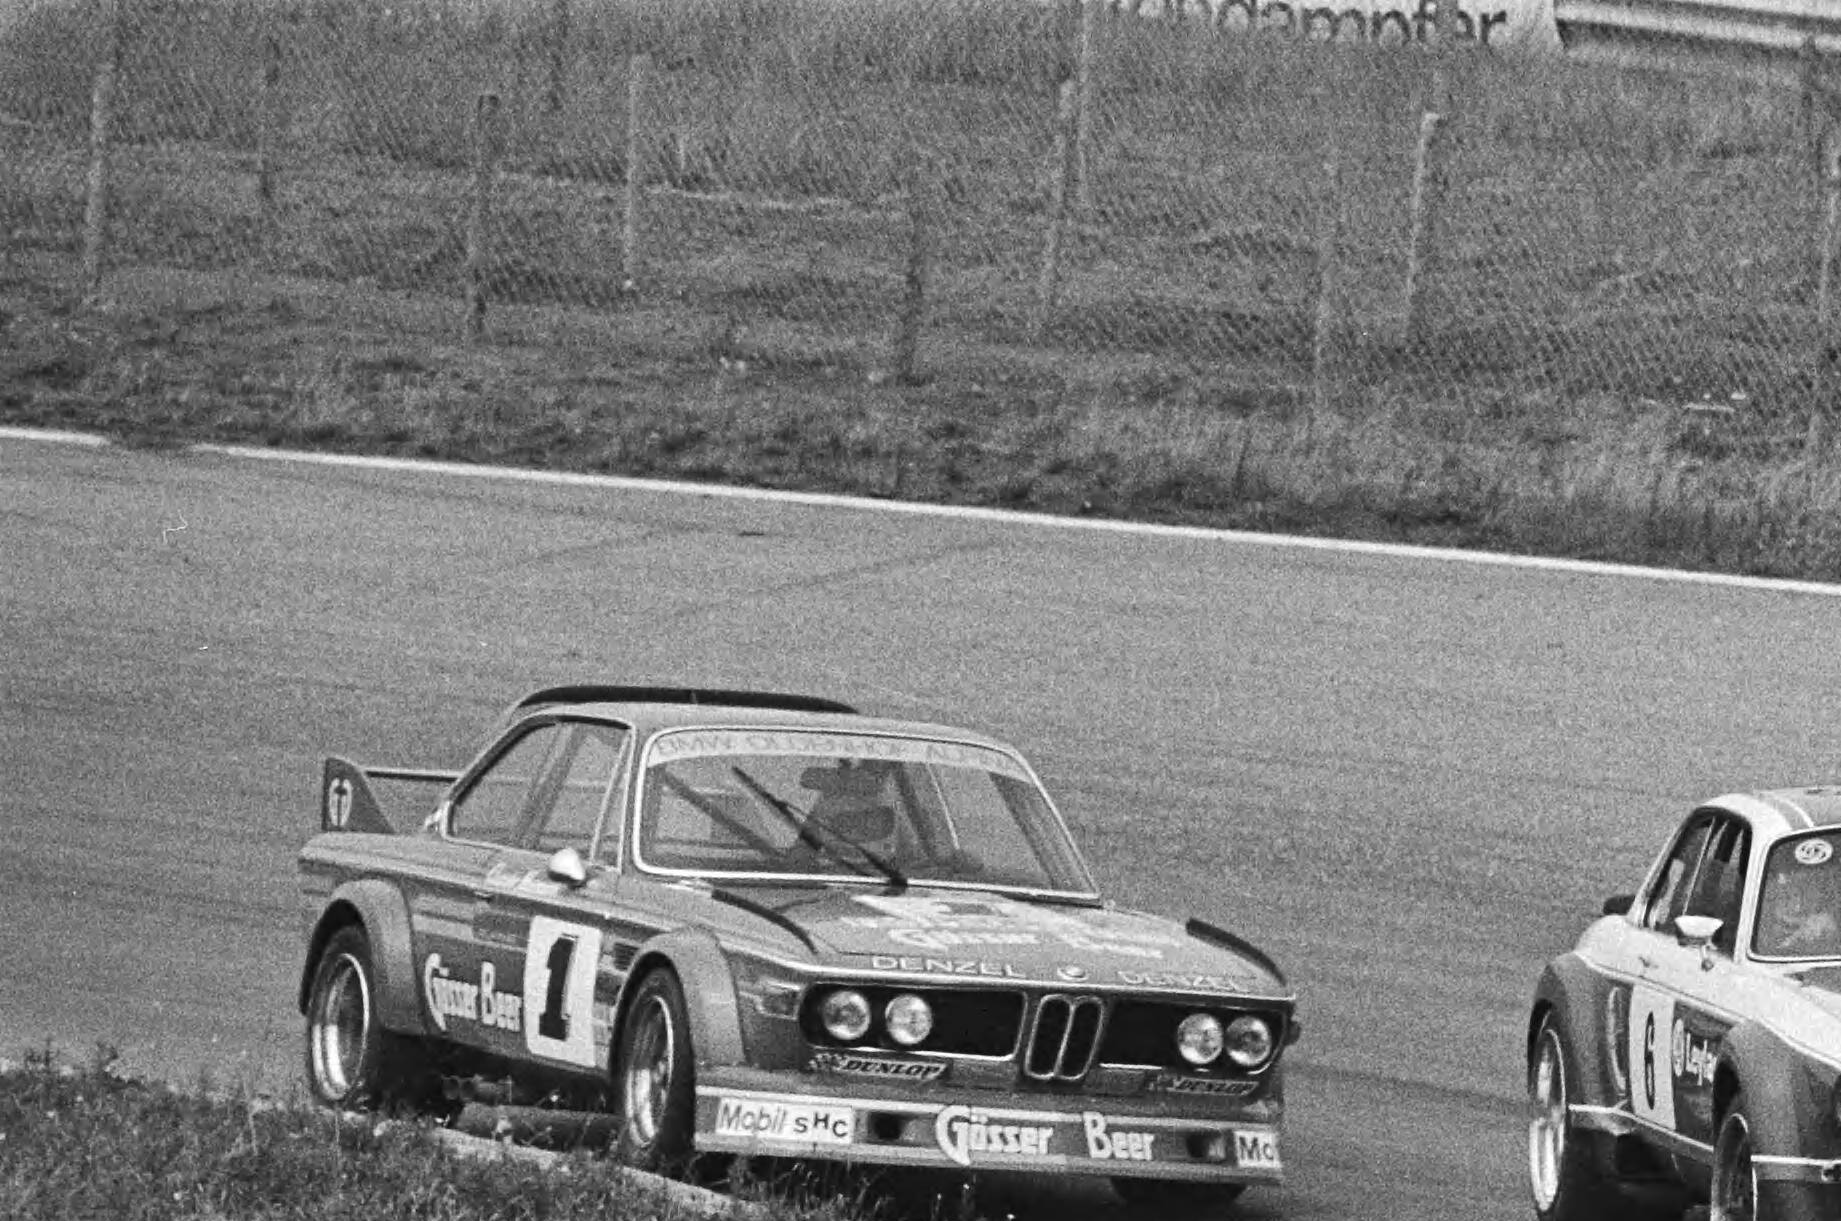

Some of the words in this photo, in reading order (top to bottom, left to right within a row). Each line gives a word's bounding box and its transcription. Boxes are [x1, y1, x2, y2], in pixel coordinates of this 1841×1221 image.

[539, 932, 580, 1042] 1
[871, 955, 1027, 979] DENZEL
[481, 961, 523, 1033] Beer
[845, 1058, 940, 1081] DUNLOP
[1644, 1011, 1656, 1111] 6
[719, 1102, 788, 1134] Mobil
[1083, 1111, 1155, 1161] Beer
